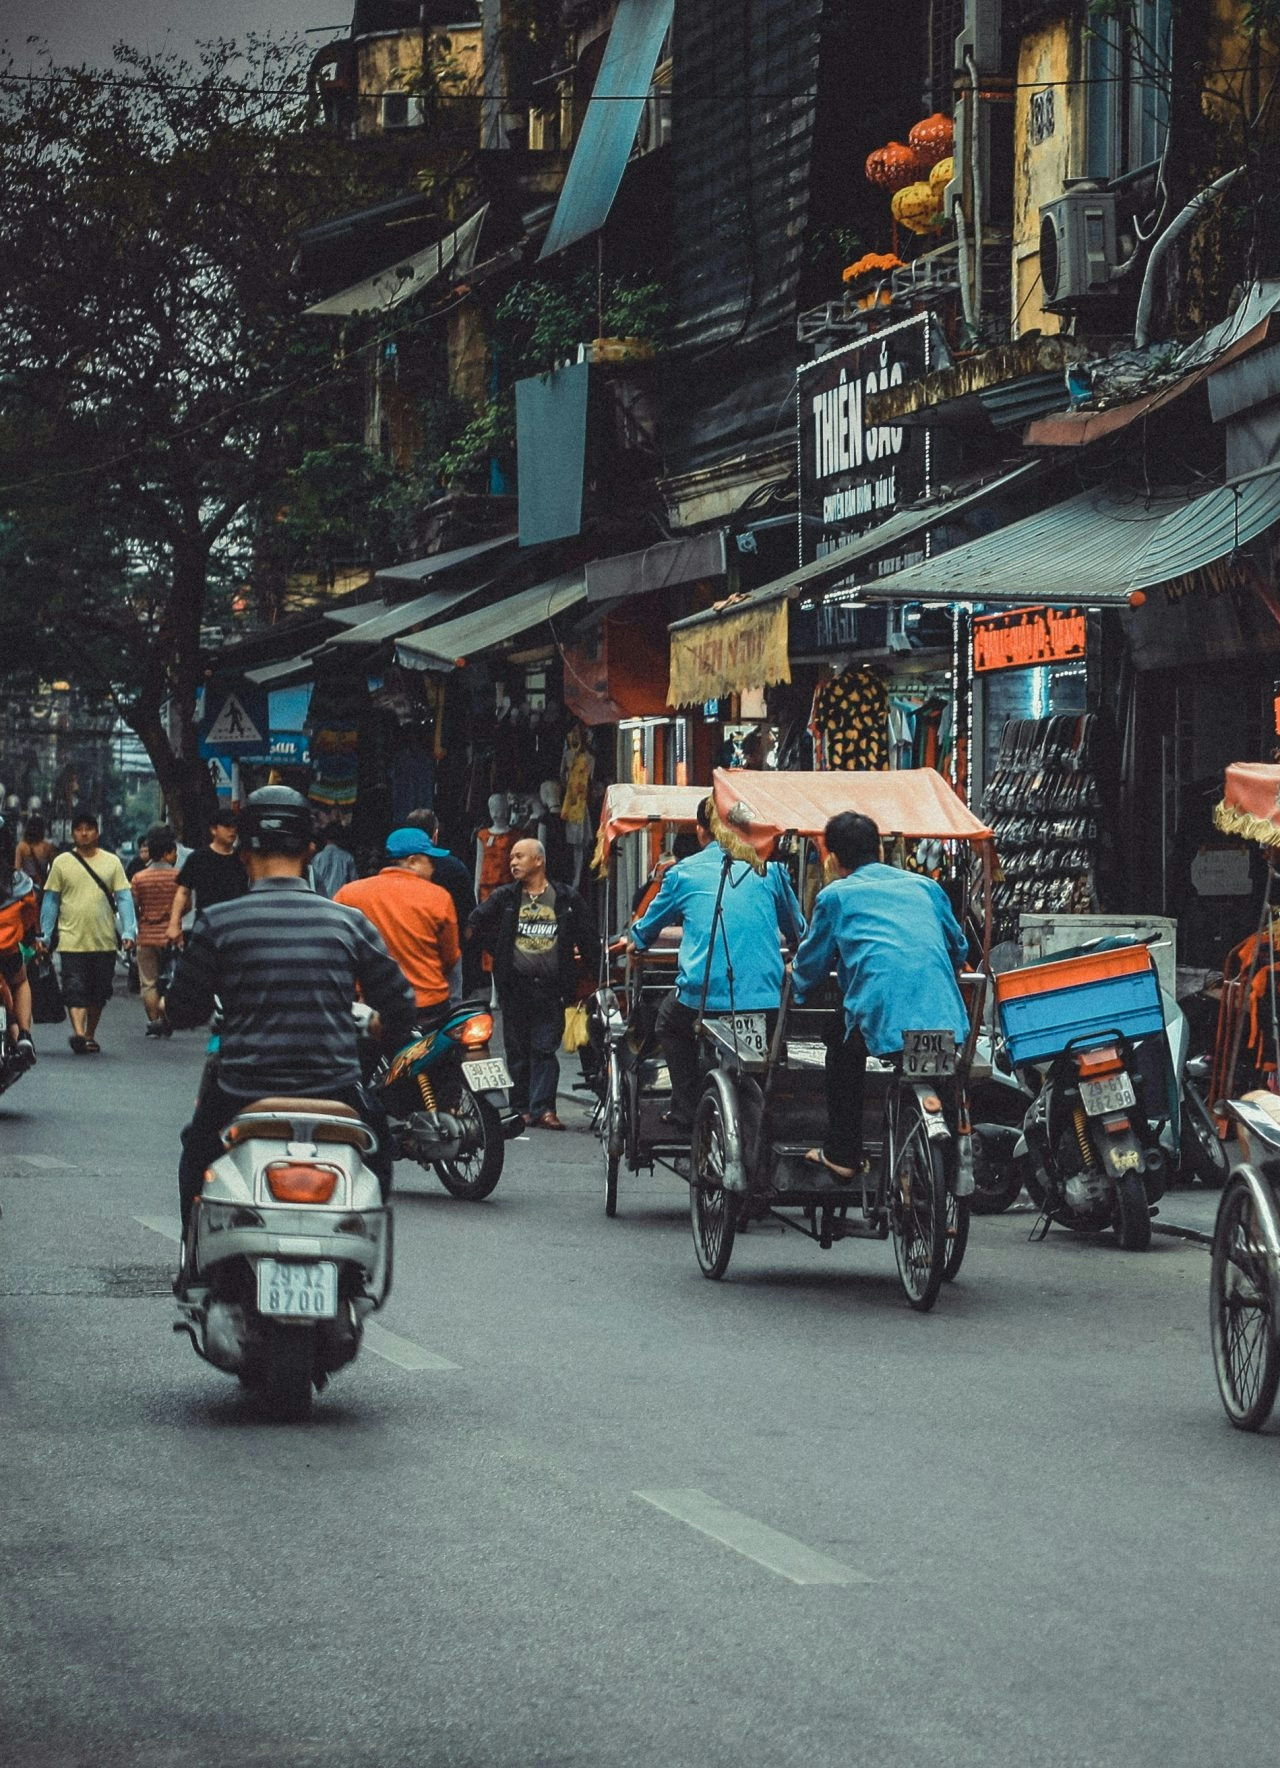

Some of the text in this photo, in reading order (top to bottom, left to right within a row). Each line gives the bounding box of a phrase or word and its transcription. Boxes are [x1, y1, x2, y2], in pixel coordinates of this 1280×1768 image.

[812, 367, 864, 480] THIÊN
[517, 922, 559, 935] PEEDWAY
[268, 1288, 327, 1313] 8700
